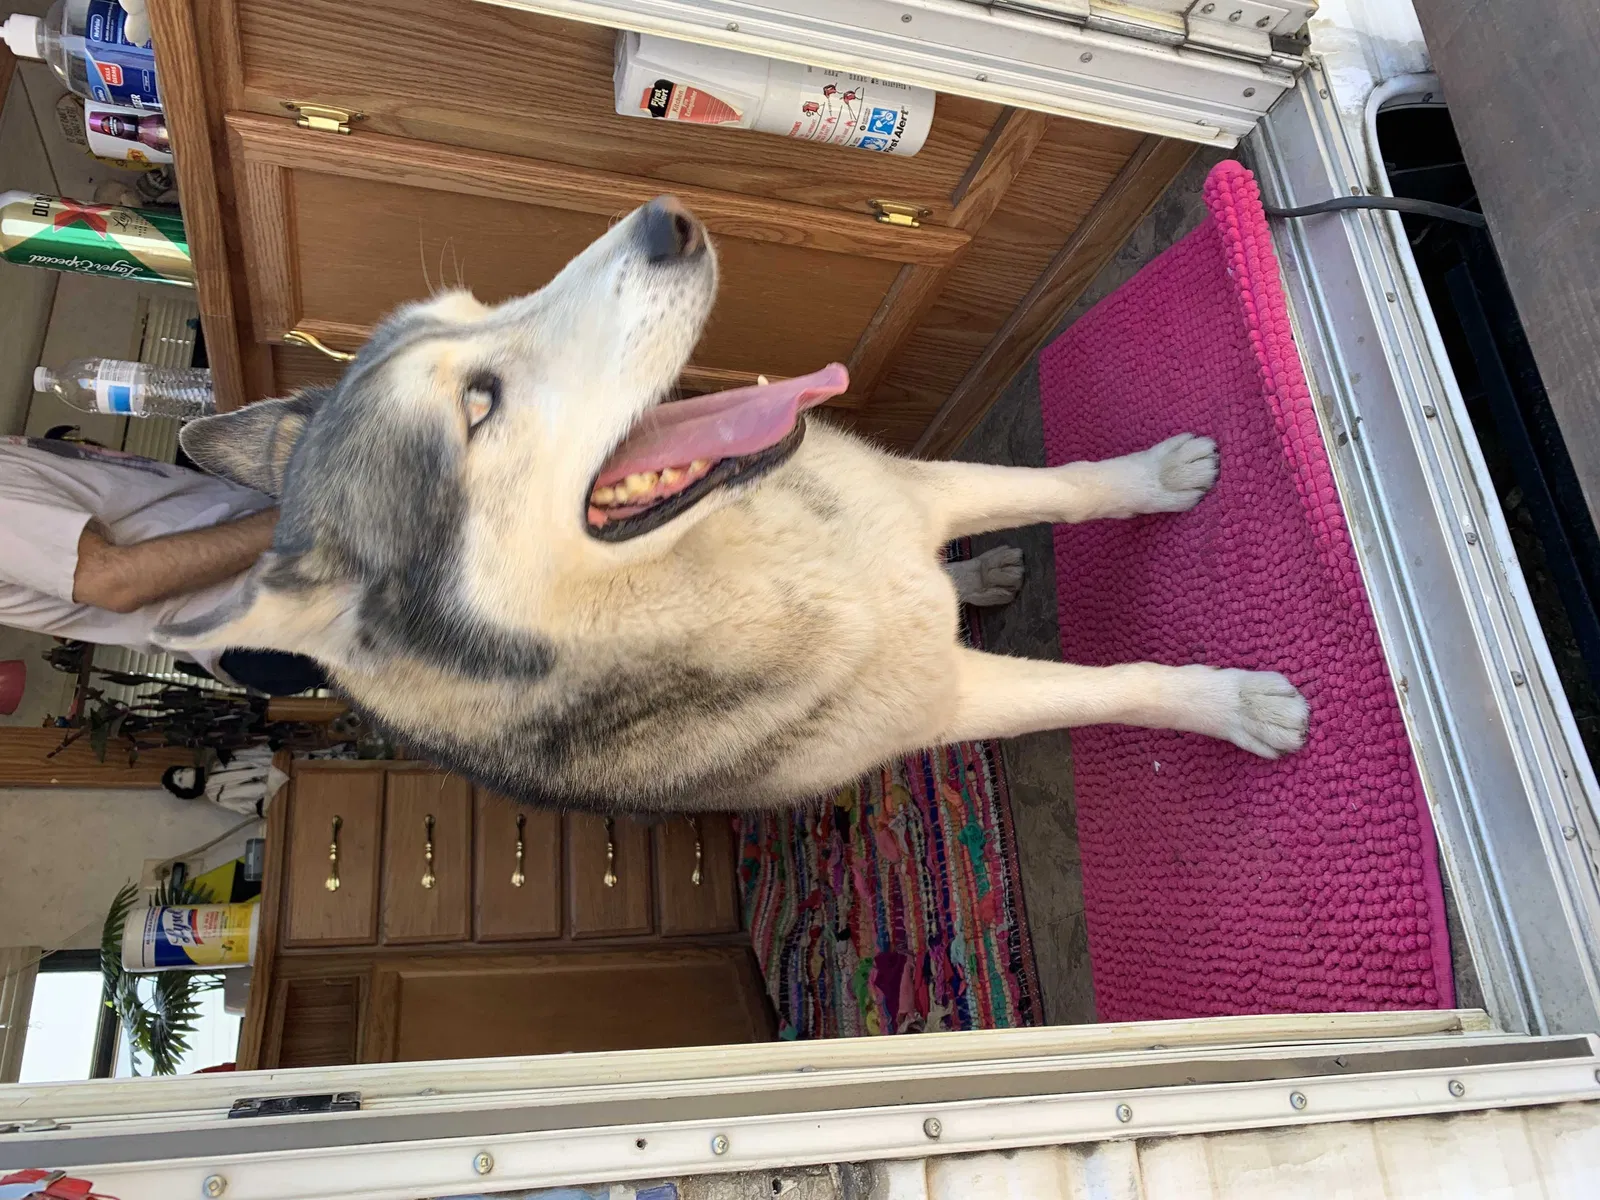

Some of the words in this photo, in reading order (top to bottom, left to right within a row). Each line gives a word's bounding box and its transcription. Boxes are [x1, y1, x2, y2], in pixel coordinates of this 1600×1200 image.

[651, 89, 661, 107] First
[658, 88, 669, 107] Alert
[672, 90, 683, 112] Kitchen
[894, 109, 909, 138] Alert
[32, 196, 52, 217] DOS
[28, 254, 96, 273] Especial
[94, 260, 143, 278] Lager
[165, 907, 191, 943] Lysol
